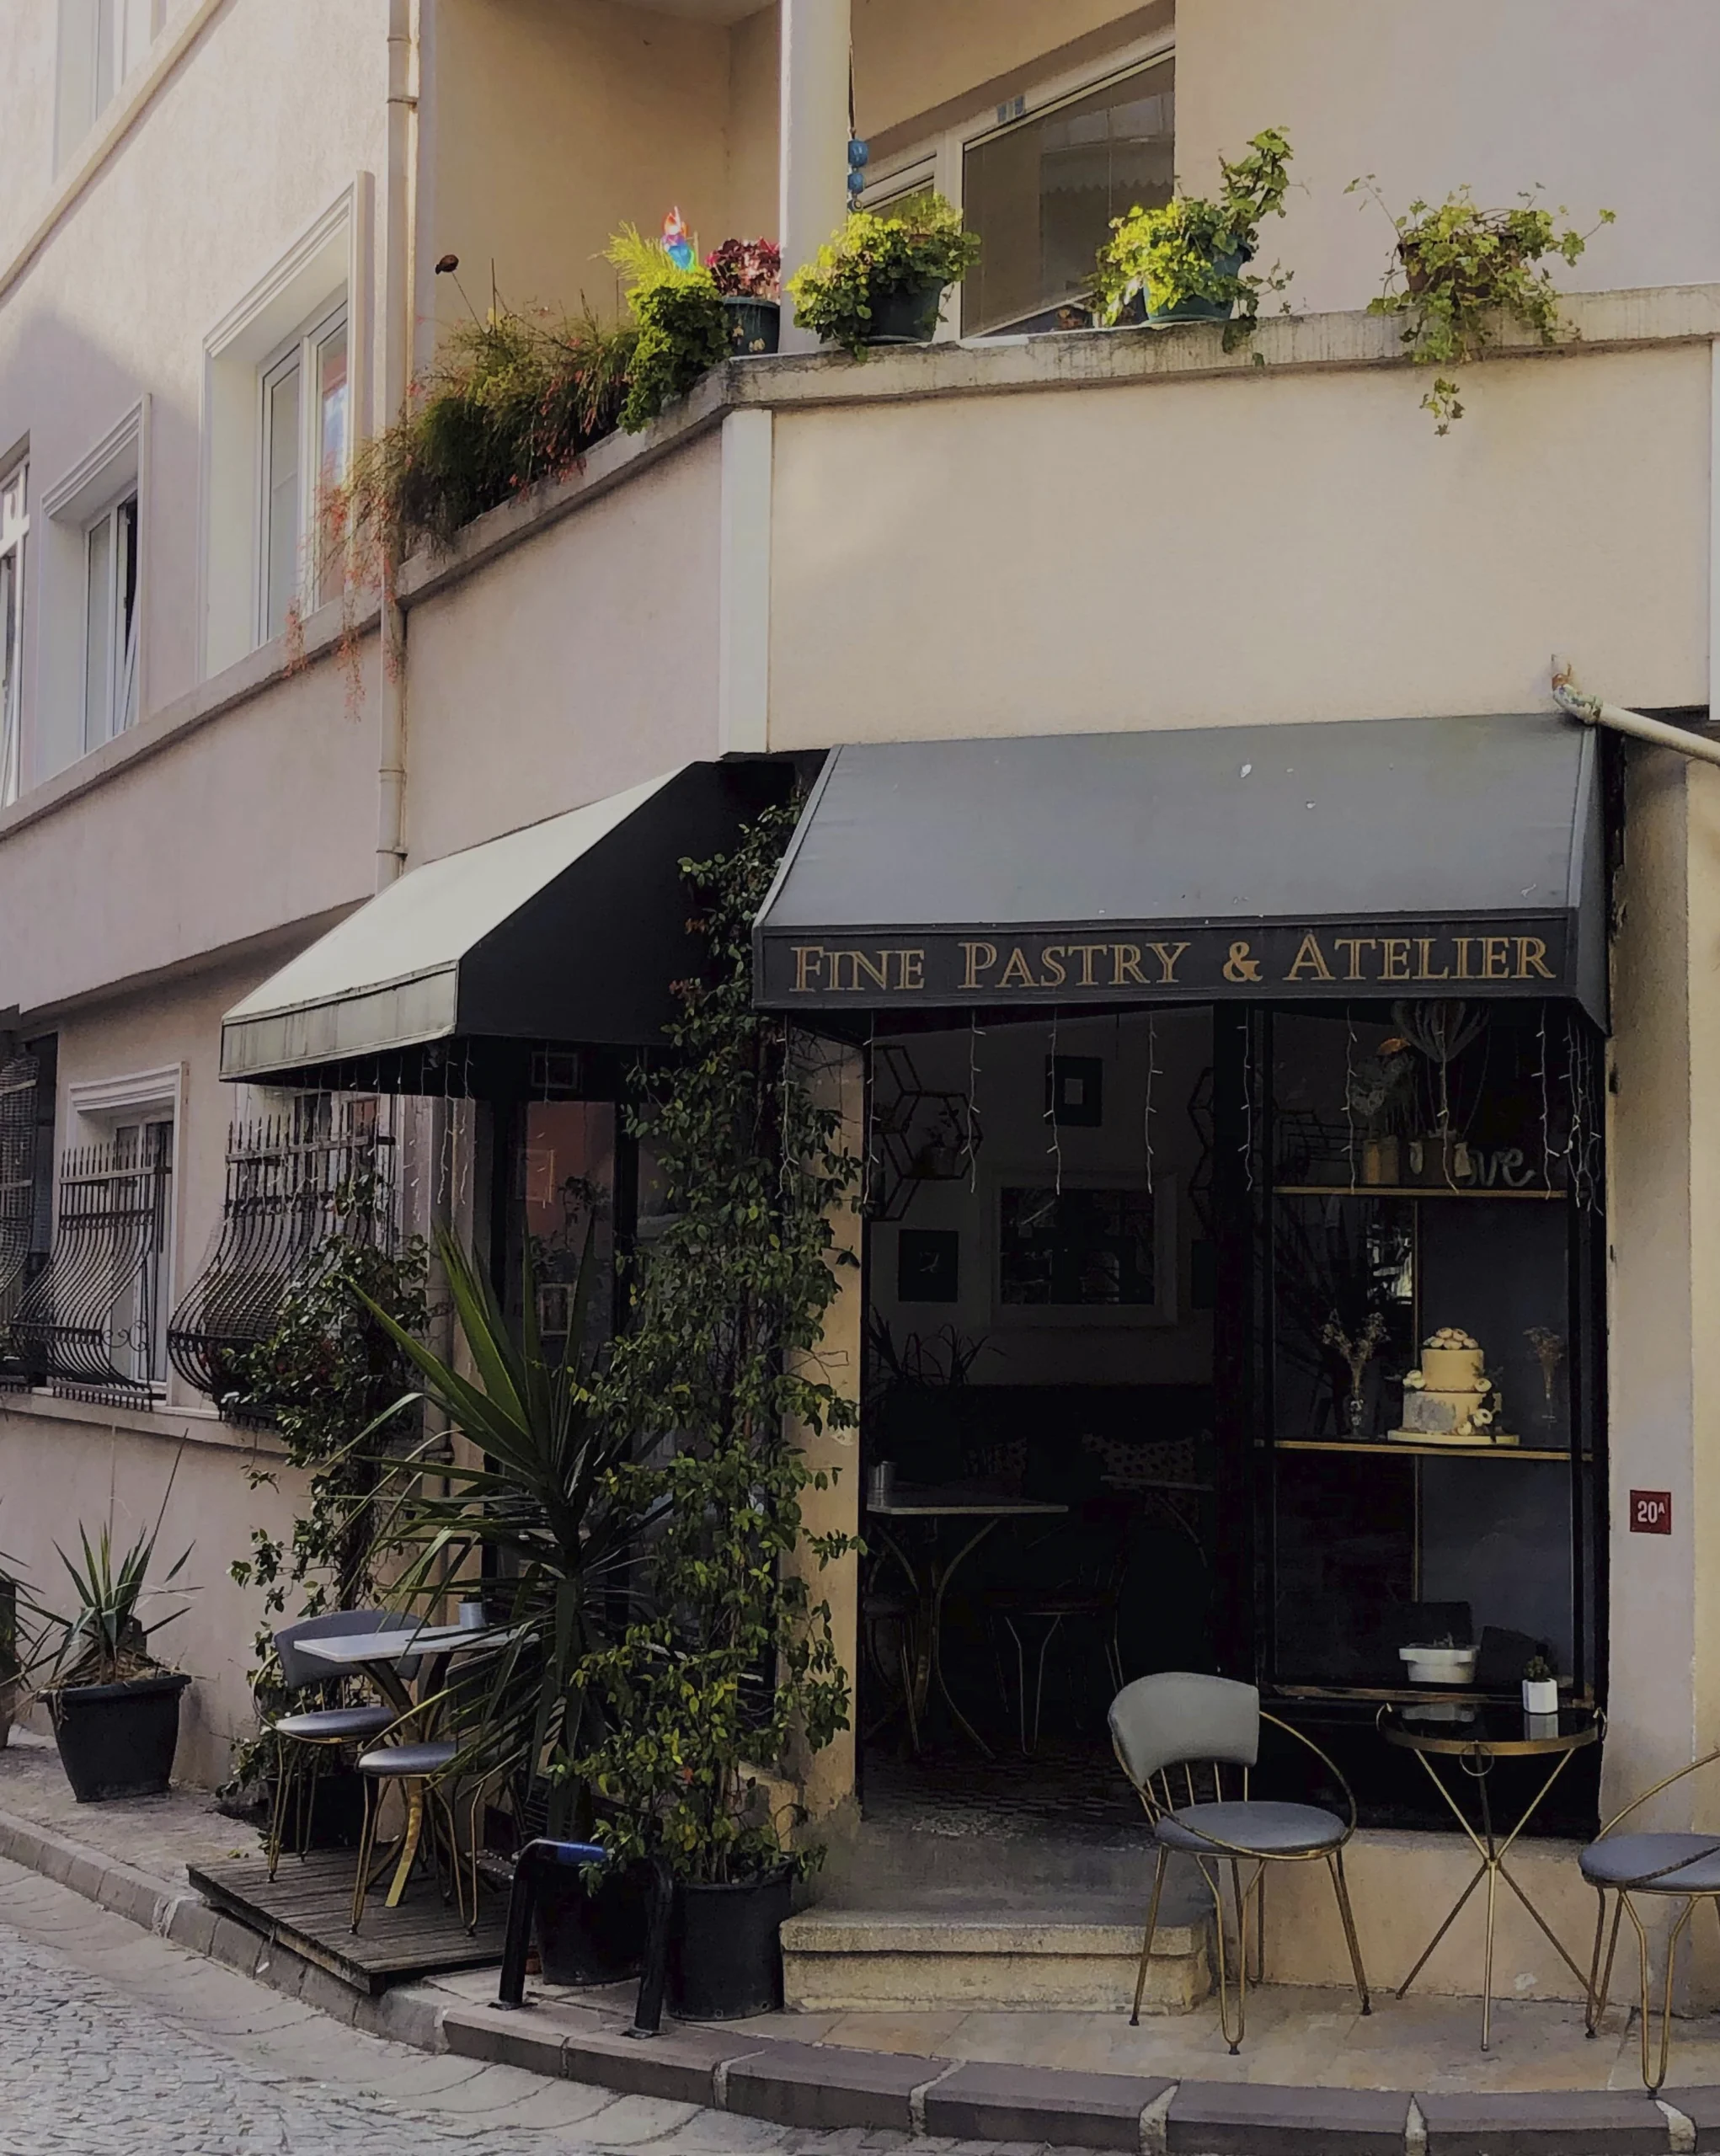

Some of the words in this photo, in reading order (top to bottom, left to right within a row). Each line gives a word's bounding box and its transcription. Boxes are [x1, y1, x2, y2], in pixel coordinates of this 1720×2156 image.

[789, 945, 926, 993] FINE
[958, 941, 1191, 989] PASTRY
[1222, 941, 1263, 982] &
[1282, 932, 1557, 981] ATELIER
[1637, 1500, 1666, 1524] 20A
